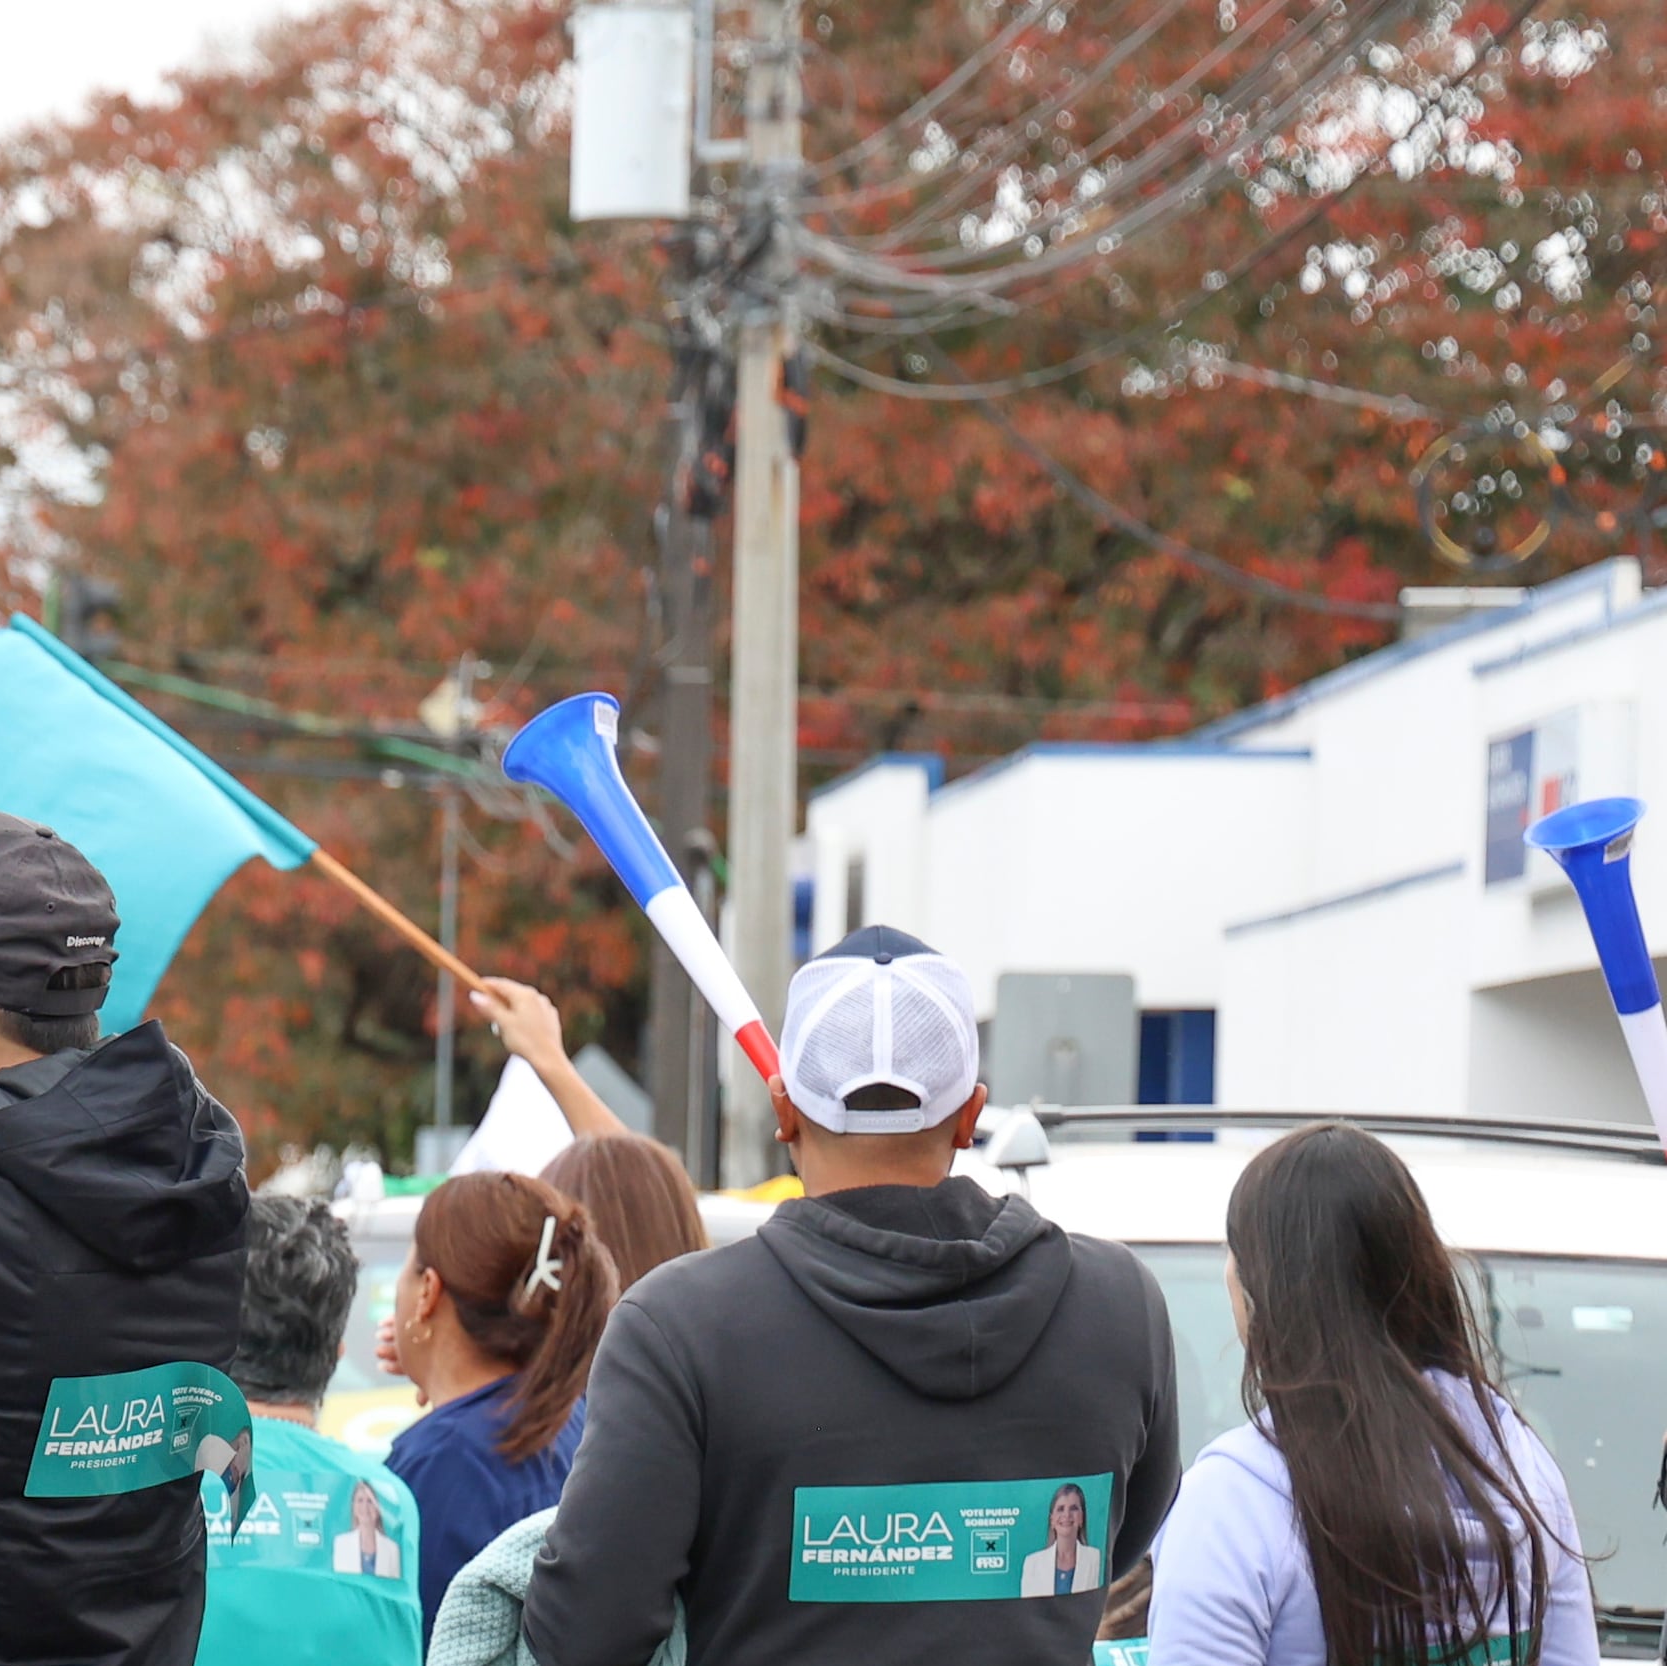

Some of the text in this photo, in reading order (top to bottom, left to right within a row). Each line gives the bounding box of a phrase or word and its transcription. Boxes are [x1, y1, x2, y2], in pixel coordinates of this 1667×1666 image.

[49, 1394, 165, 1438] LAURA
[44, 1428, 163, 1456] FERNÁNDEZ
[70, 1454, 138, 1469] PRESIDENTE
[959, 1507, 1020, 1517] VOTE PUEBLO
[804, 1511, 954, 1546] LAURA
[964, 1517, 1016, 1527] SOBERANO
[802, 1545, 953, 1564] FERNÁNDEZ
[833, 1565, 916, 1577] PRESIDENTE
